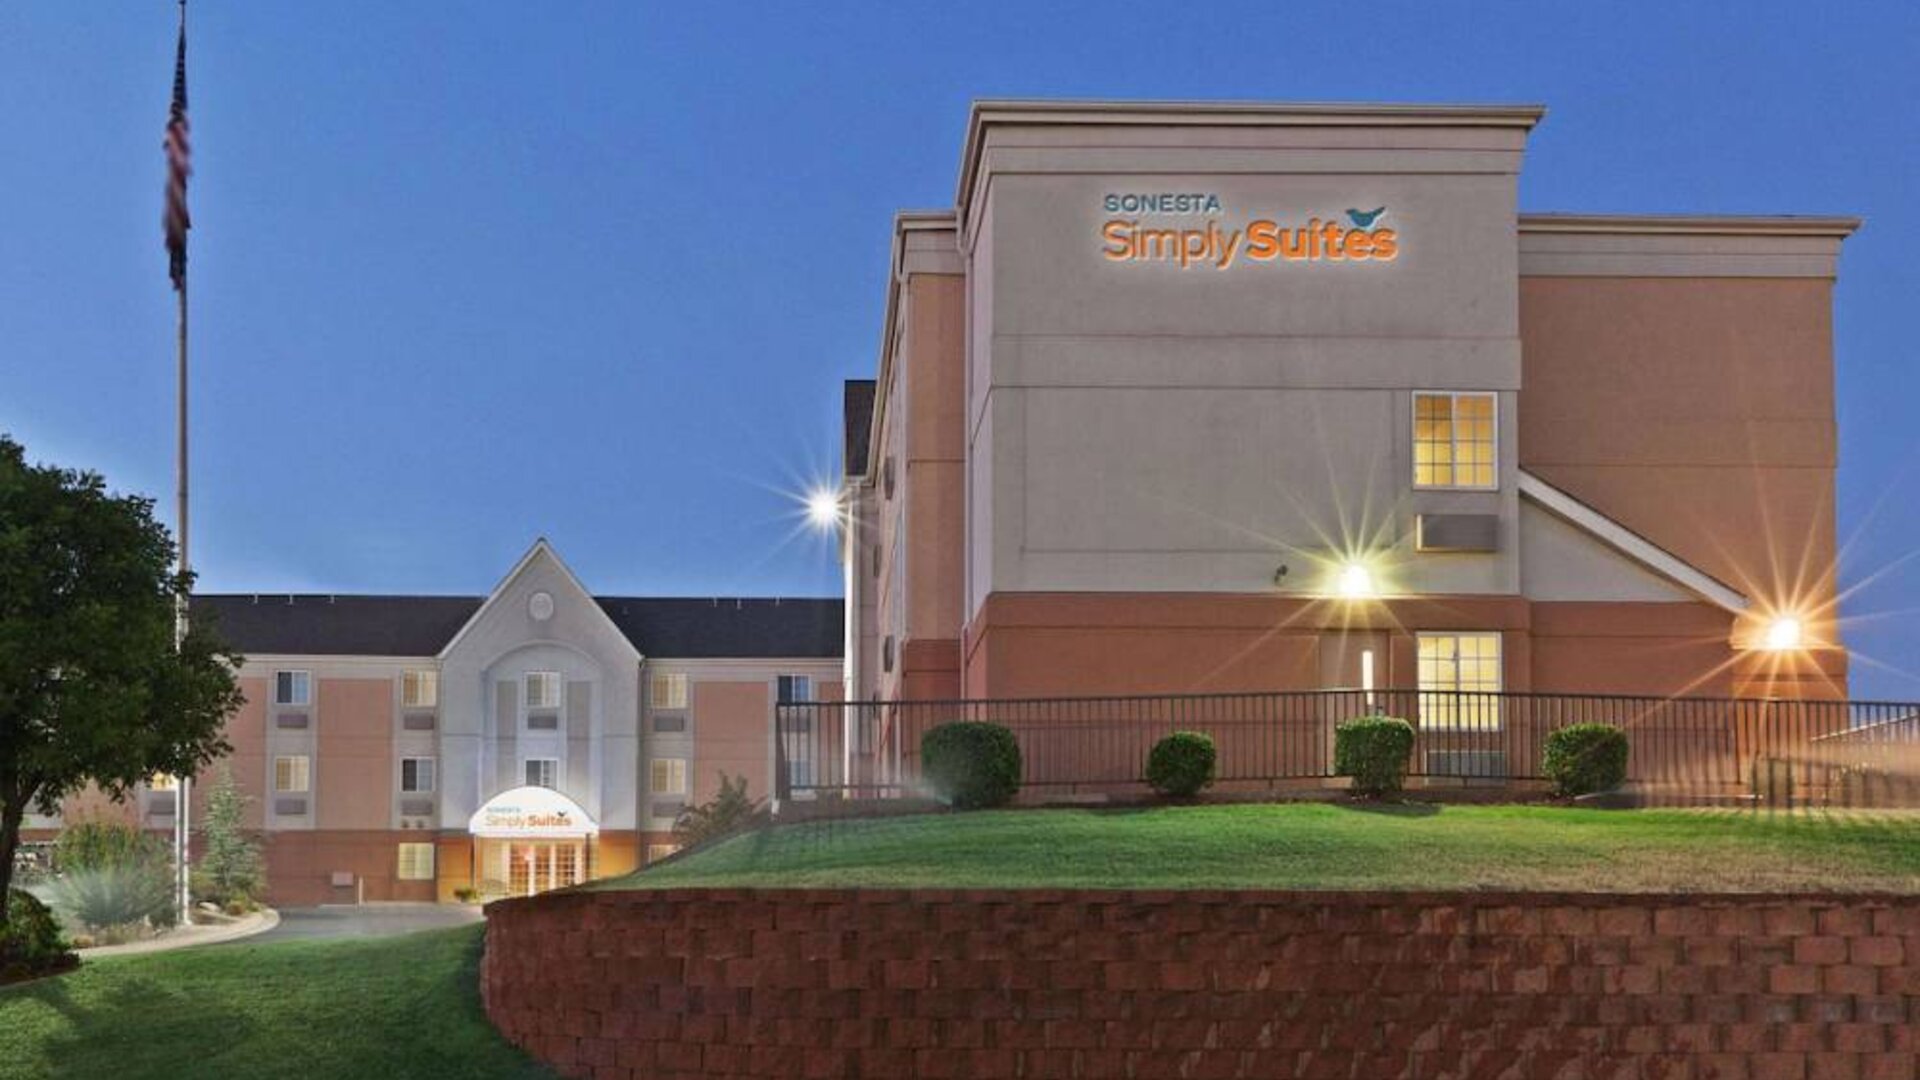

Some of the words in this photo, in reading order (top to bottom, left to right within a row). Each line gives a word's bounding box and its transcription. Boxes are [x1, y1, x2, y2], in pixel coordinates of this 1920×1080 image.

[1104, 193, 1221, 212] SONESTA
[1102, 219, 1242, 269] Simply
[1246, 217, 1398, 260] Suites
[527, 813, 572, 827] Suites
